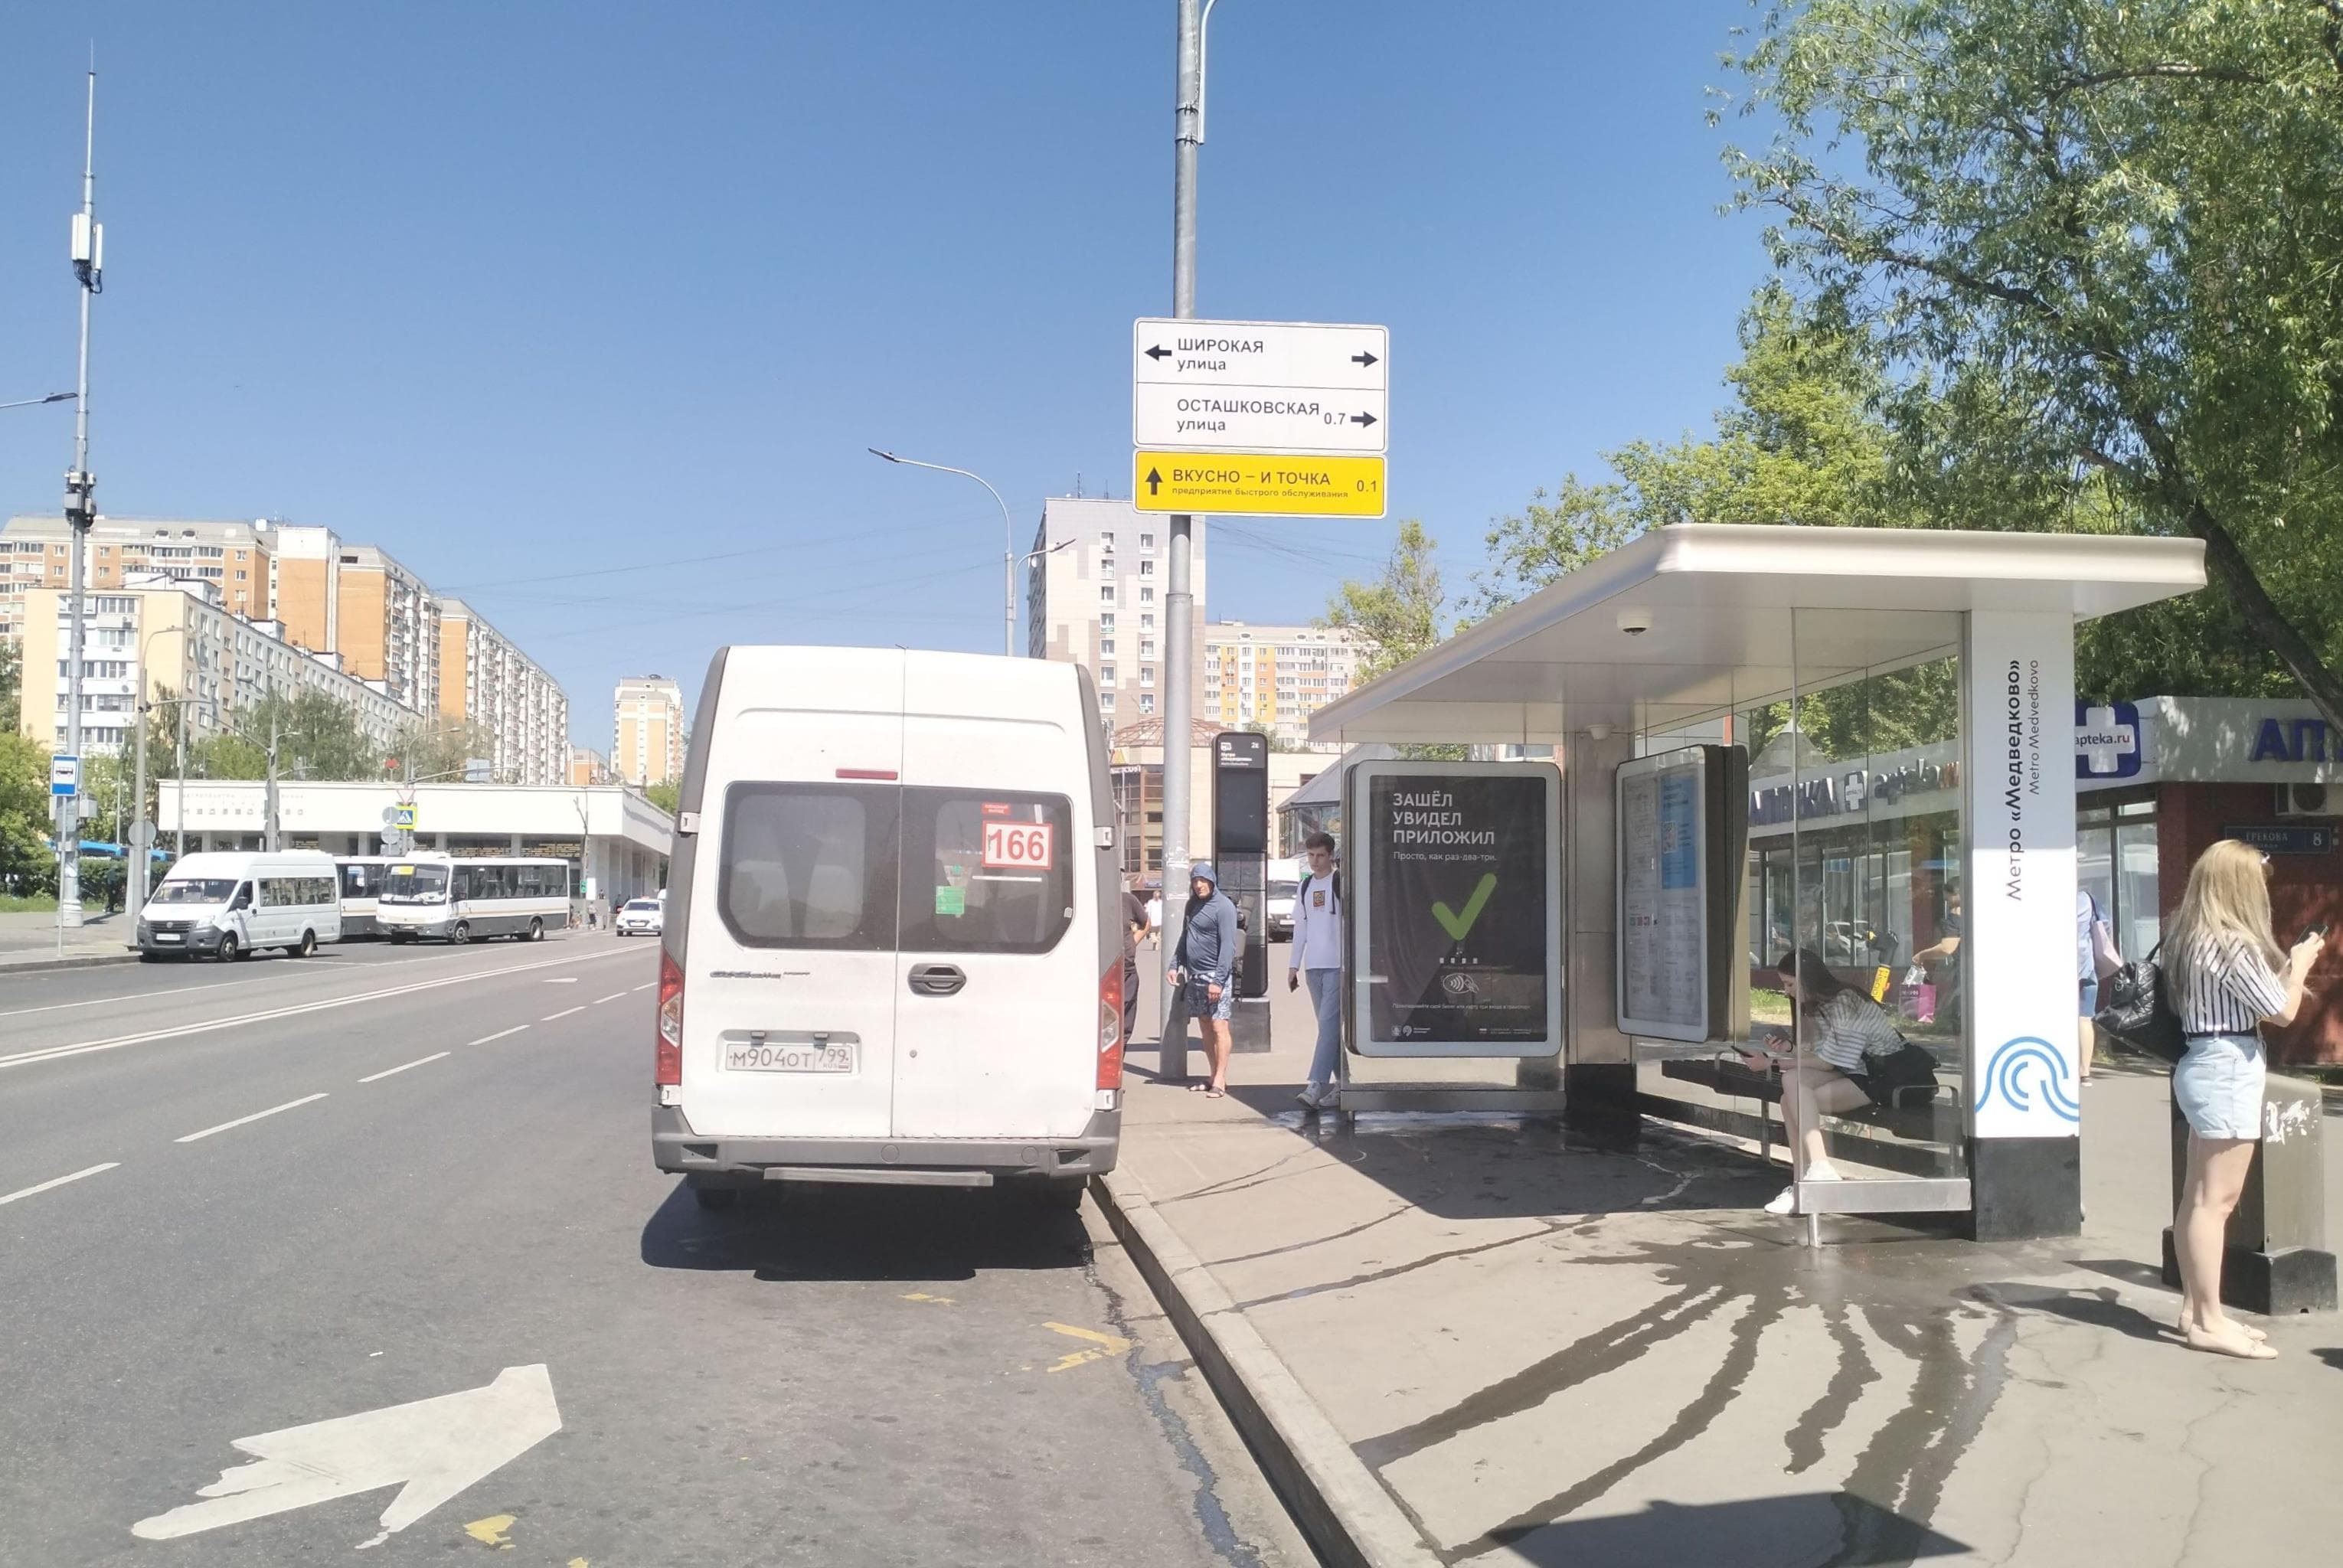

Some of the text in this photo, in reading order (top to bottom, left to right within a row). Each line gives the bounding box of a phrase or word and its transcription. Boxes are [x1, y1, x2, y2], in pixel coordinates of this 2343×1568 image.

[1178, 338, 1264, 353] ШИРОКАЯ
[1177, 359, 1227, 372] улица
[1177, 398, 1320, 416] ОСТАШКОВСКАЯ
[1177, 420, 1226, 433] улица
[1324, 412, 1346, 426] 0.7
[1173, 469, 1240, 483] ВКУСНО
[1260, 471, 1272, 484] И
[1276, 472, 1331, 485] ТОЧКА
[1172, 487, 1348, 499] предприятие быстрого обслуживания
[1356, 479, 1377, 492] 0.1
[2028, 659, 2040, 795] Metro Medvedkovo
[2076, 732, 2131, 747] apteka.ru
[2250, 718, 2343, 763] АП
[2005, 660, 2024, 901] Метро «Медведково»
[1393, 790, 1453, 807] ЗАШЁЛ
[1393, 811, 1462, 828] УВИДЕЛ
[989, 828, 1044, 861] 166
[1394, 830, 1495, 845] ПРИЛОЖИЛ
[2312, 832, 2322, 846] 8
[1394, 851, 1427, 861] Просто,
